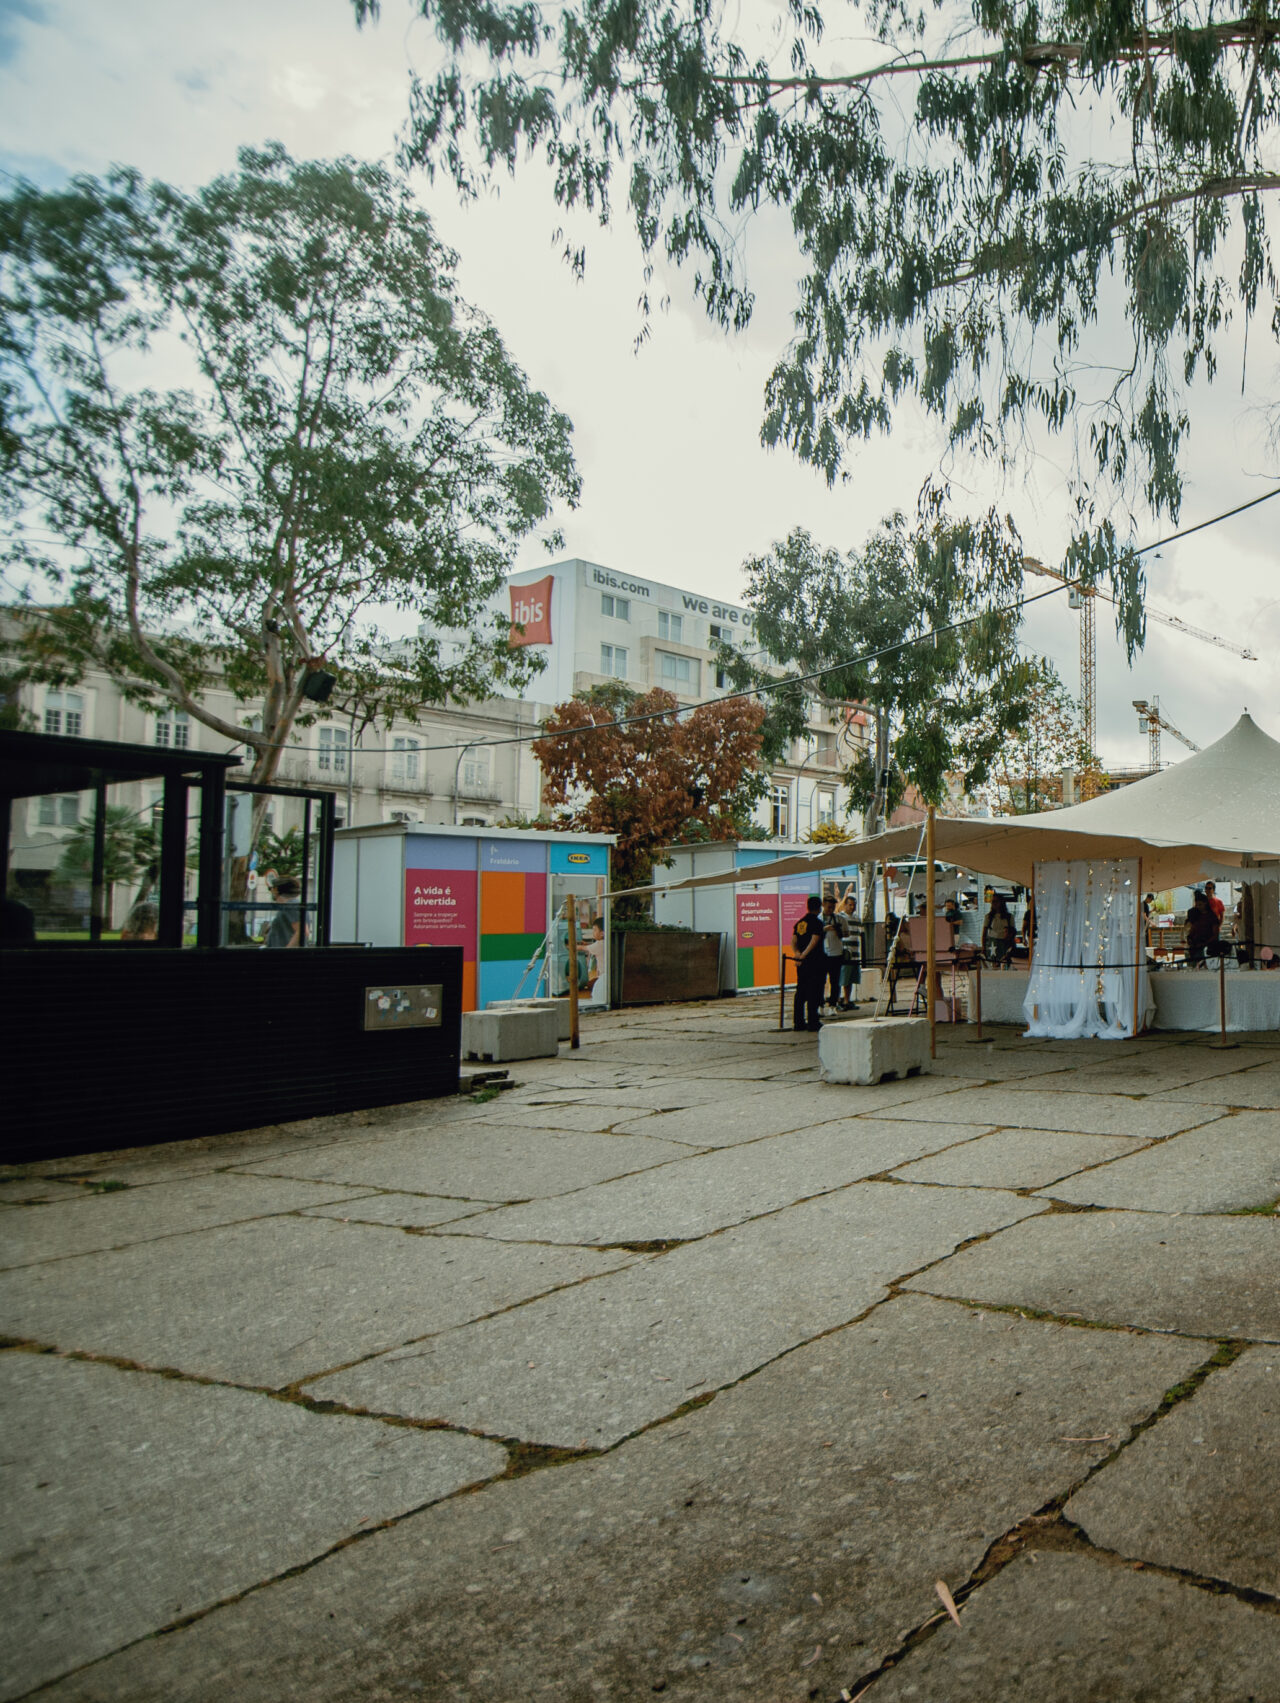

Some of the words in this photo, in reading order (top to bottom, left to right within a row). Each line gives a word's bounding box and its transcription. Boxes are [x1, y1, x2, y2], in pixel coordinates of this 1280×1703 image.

[593, 569, 650, 597] ibis.com
[514, 598, 544, 625] ibis
[682, 595, 709, 614] we
[711, 605, 738, 623] are
[414, 886, 422, 895] A
[423, 885, 443, 895] vida
[445, 885, 451, 895] é
[414, 897, 457, 906] divertida
